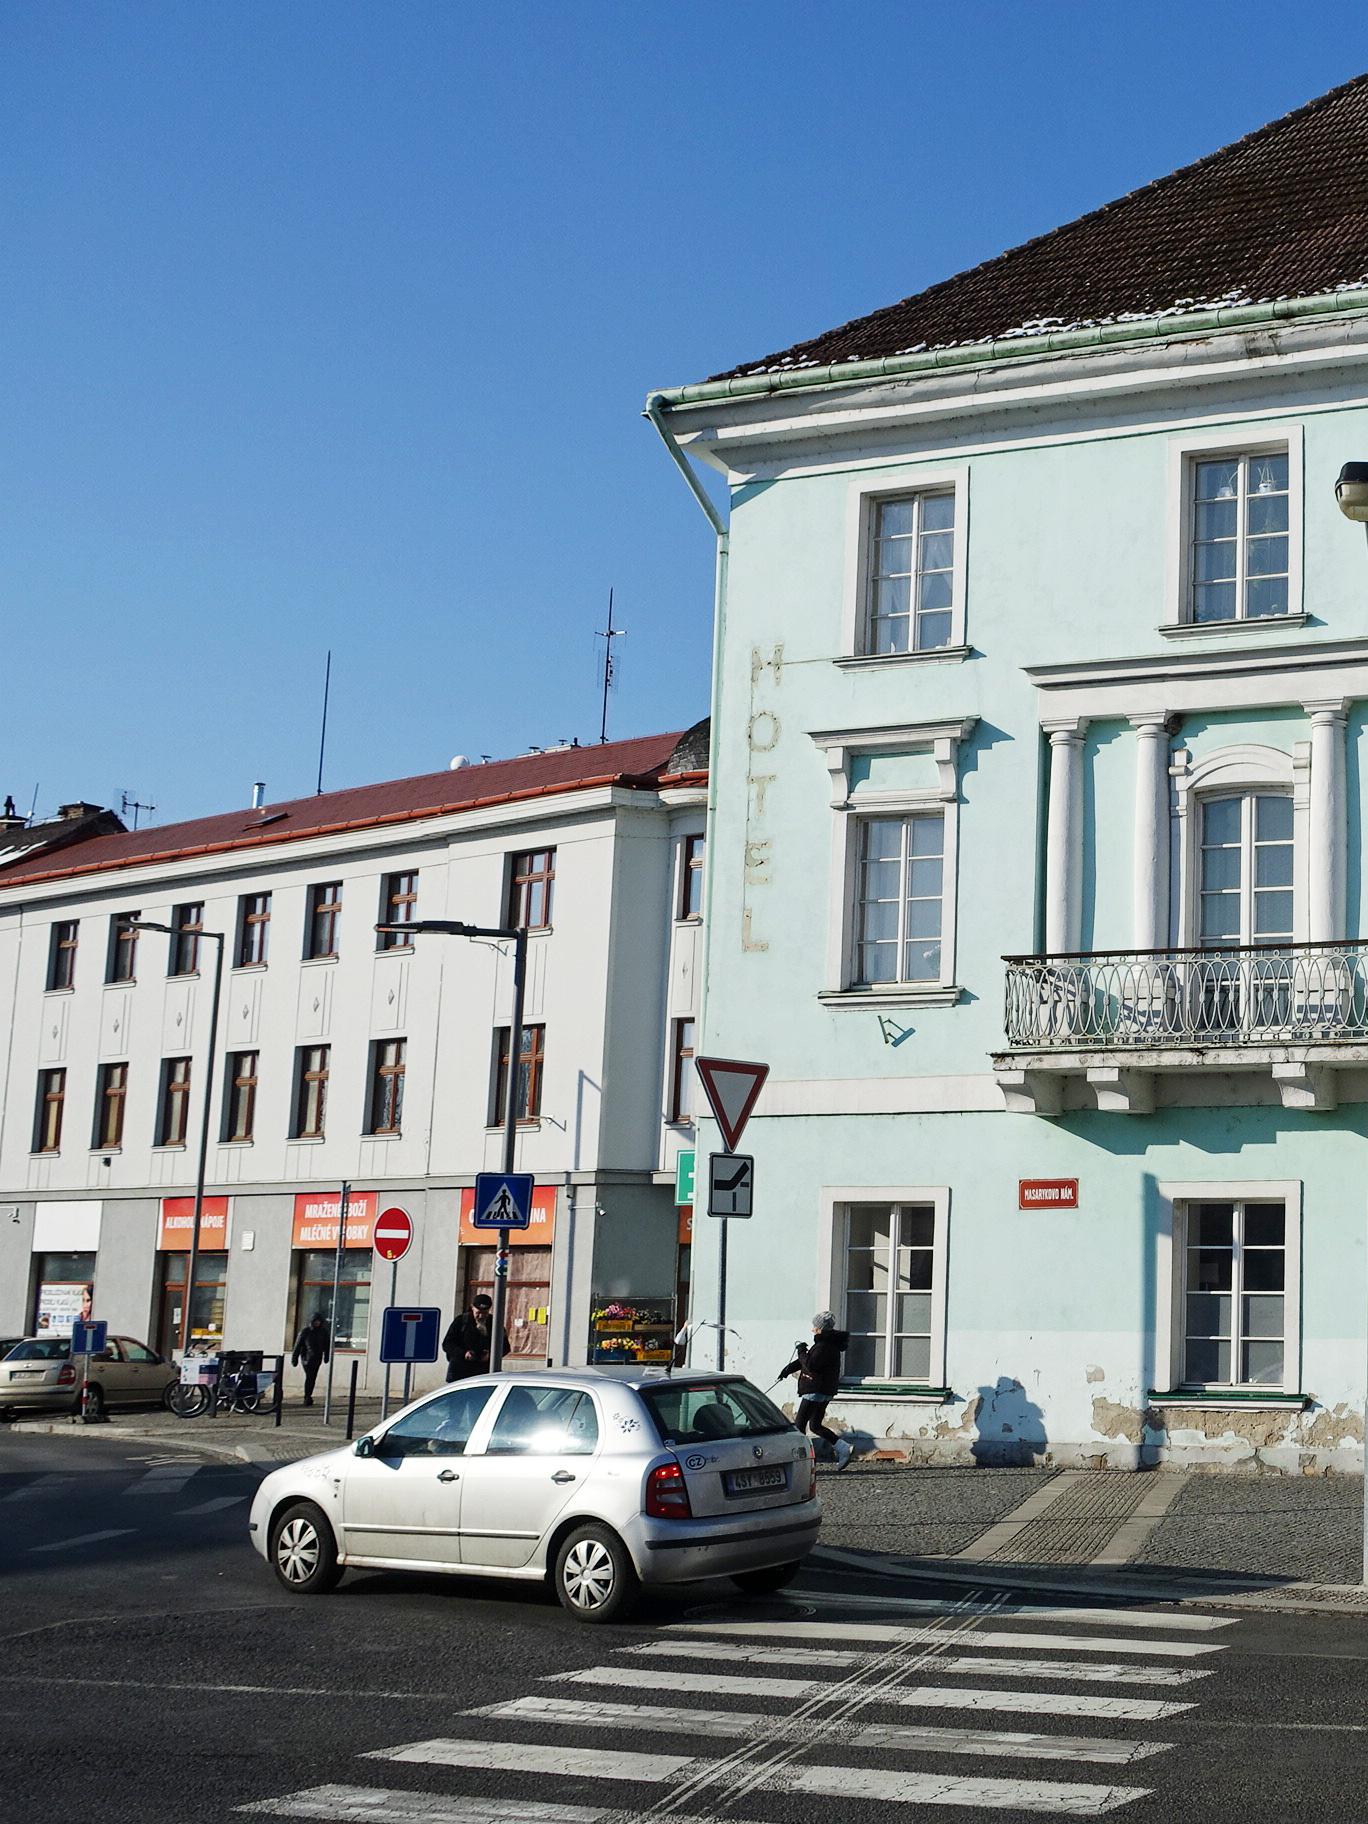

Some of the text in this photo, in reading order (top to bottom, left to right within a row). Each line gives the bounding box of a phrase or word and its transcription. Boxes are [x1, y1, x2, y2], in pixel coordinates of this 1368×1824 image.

[1024, 1185, 1074, 1201] MASARYKOVO NÁM.
[688, 1458, 702, 1468] CZ
